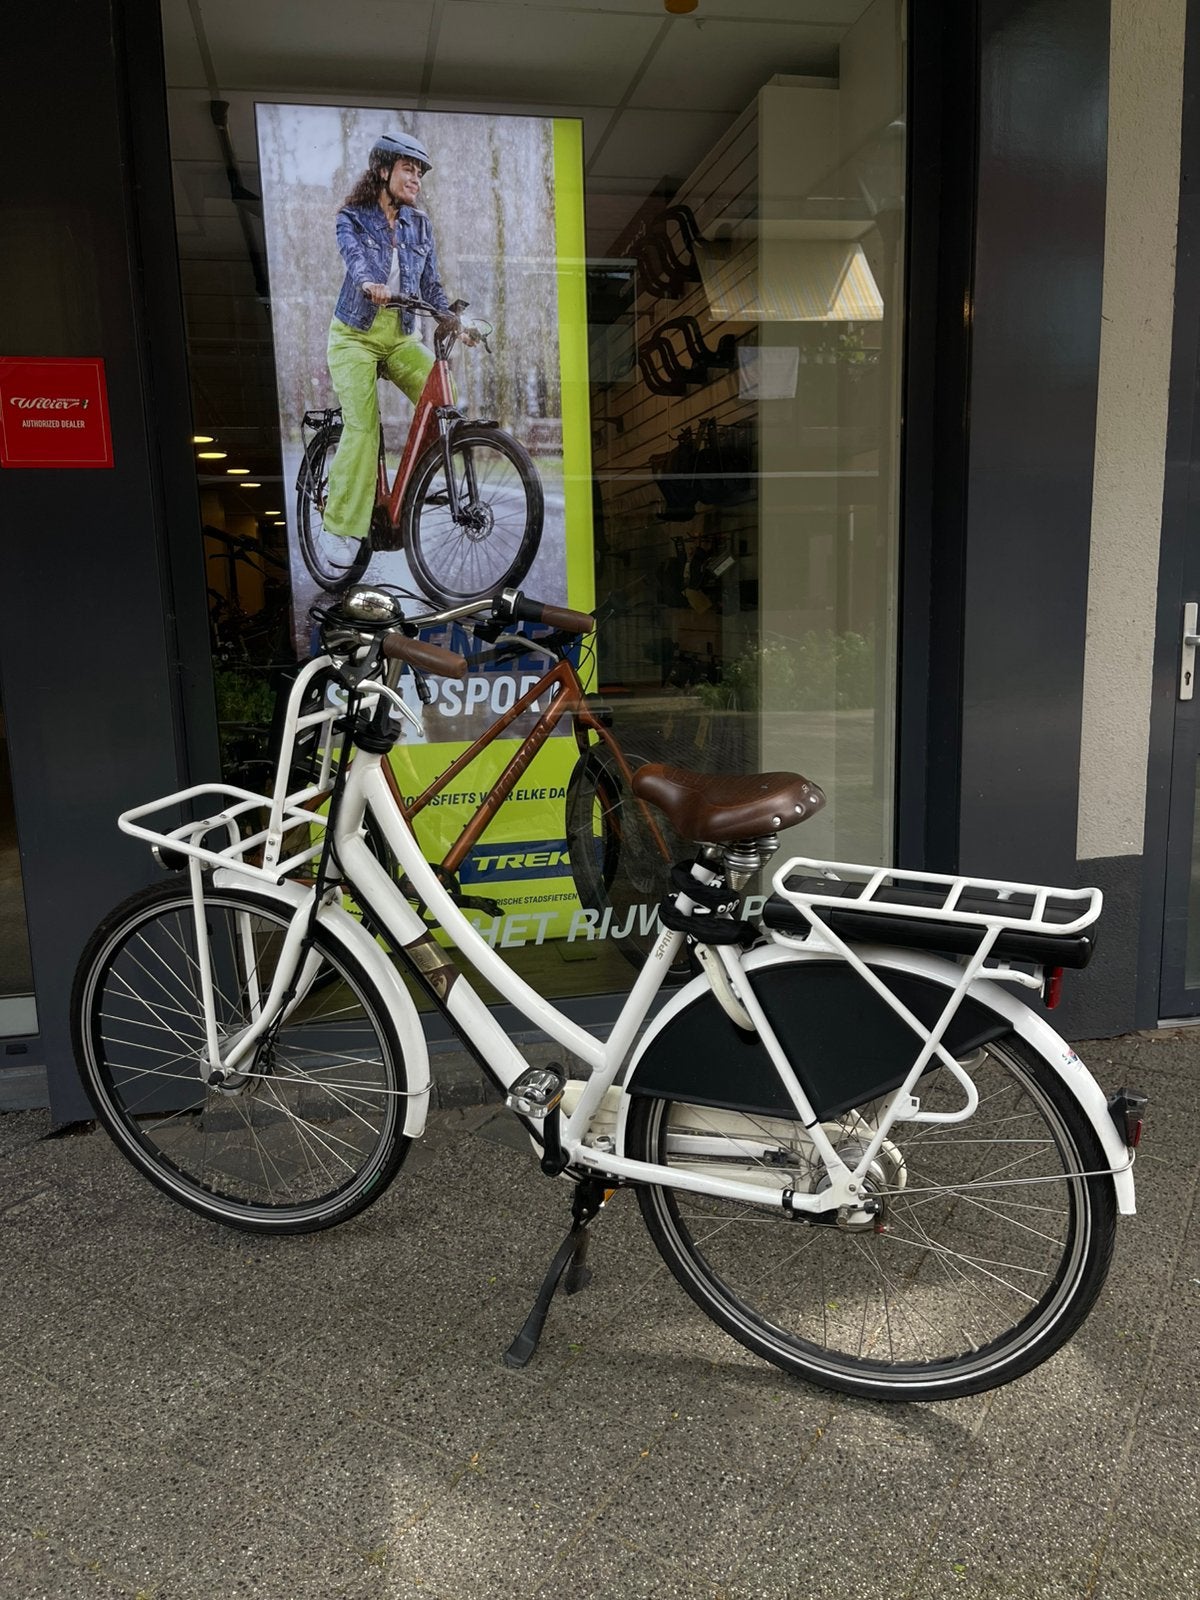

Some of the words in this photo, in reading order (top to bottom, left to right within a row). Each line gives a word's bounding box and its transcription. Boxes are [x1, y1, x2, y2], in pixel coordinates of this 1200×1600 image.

[22, 419, 60, 428] AUTHORIZED
[61, 420, 85, 428] DEALER
[516, 787, 547, 801] ELKE
[549, 786, 567, 799] DA
[472, 851, 571, 871] TREK
[524, 892, 578, 904] STADSFIETSEN
[472, 910, 559, 949] HET
[655, 930, 674, 961] SPAR
